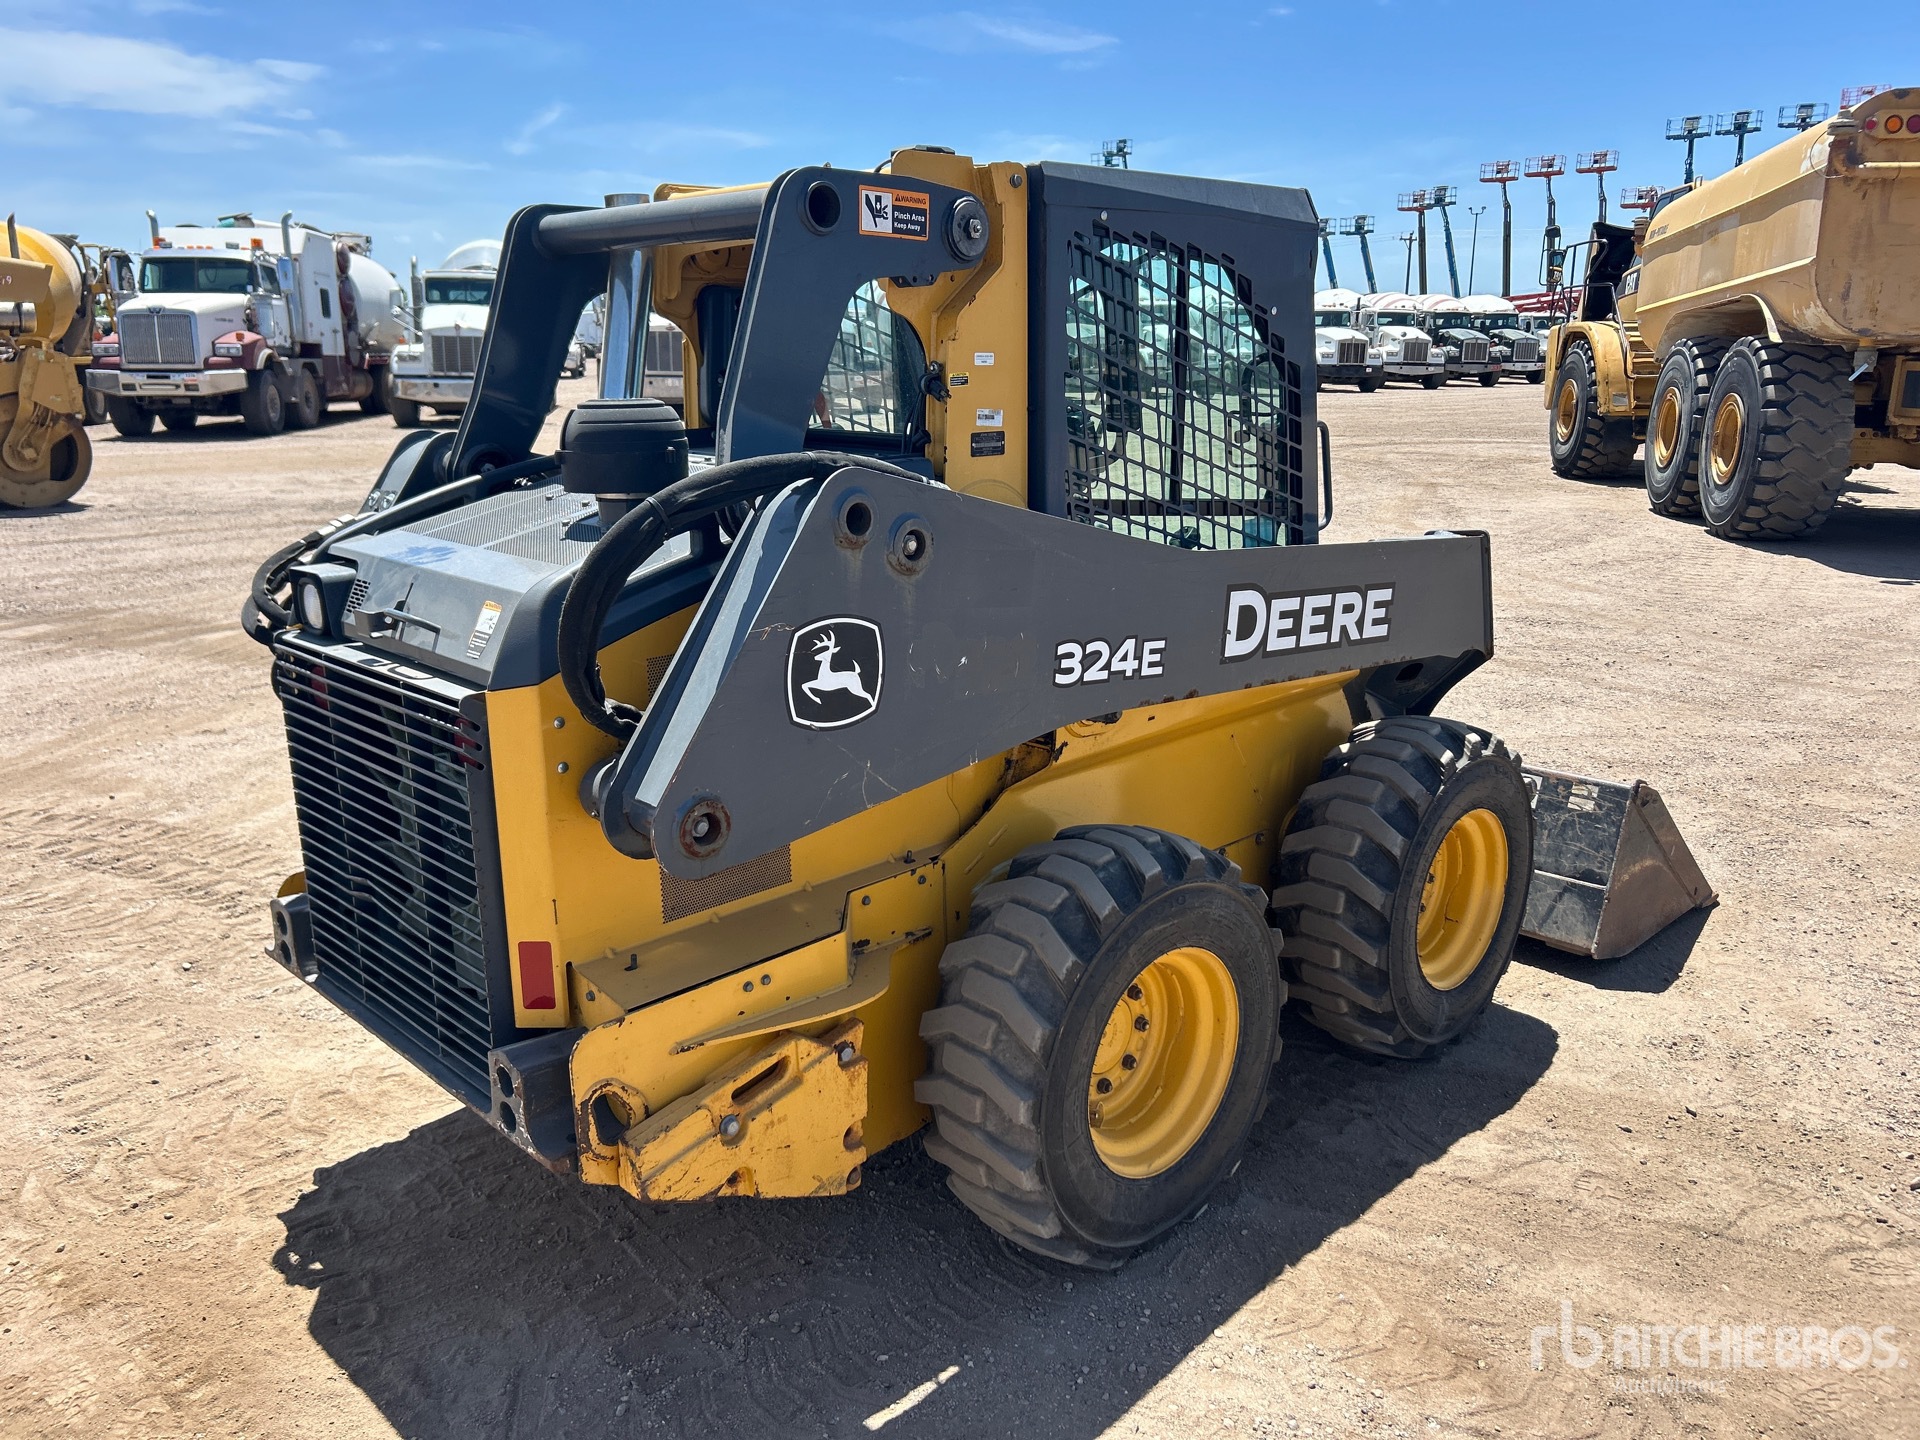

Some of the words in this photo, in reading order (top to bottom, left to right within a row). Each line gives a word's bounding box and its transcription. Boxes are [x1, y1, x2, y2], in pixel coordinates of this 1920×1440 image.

[900, 195, 927, 205] WARNING
[894, 211, 911, 220] Pinch
[911, 213, 925, 222] Area
[893, 222, 907, 230] Keep
[907, 223, 921, 232] Away
[1223, 587, 1394, 659] DEERE
[1054, 637, 1166, 686] 324E
